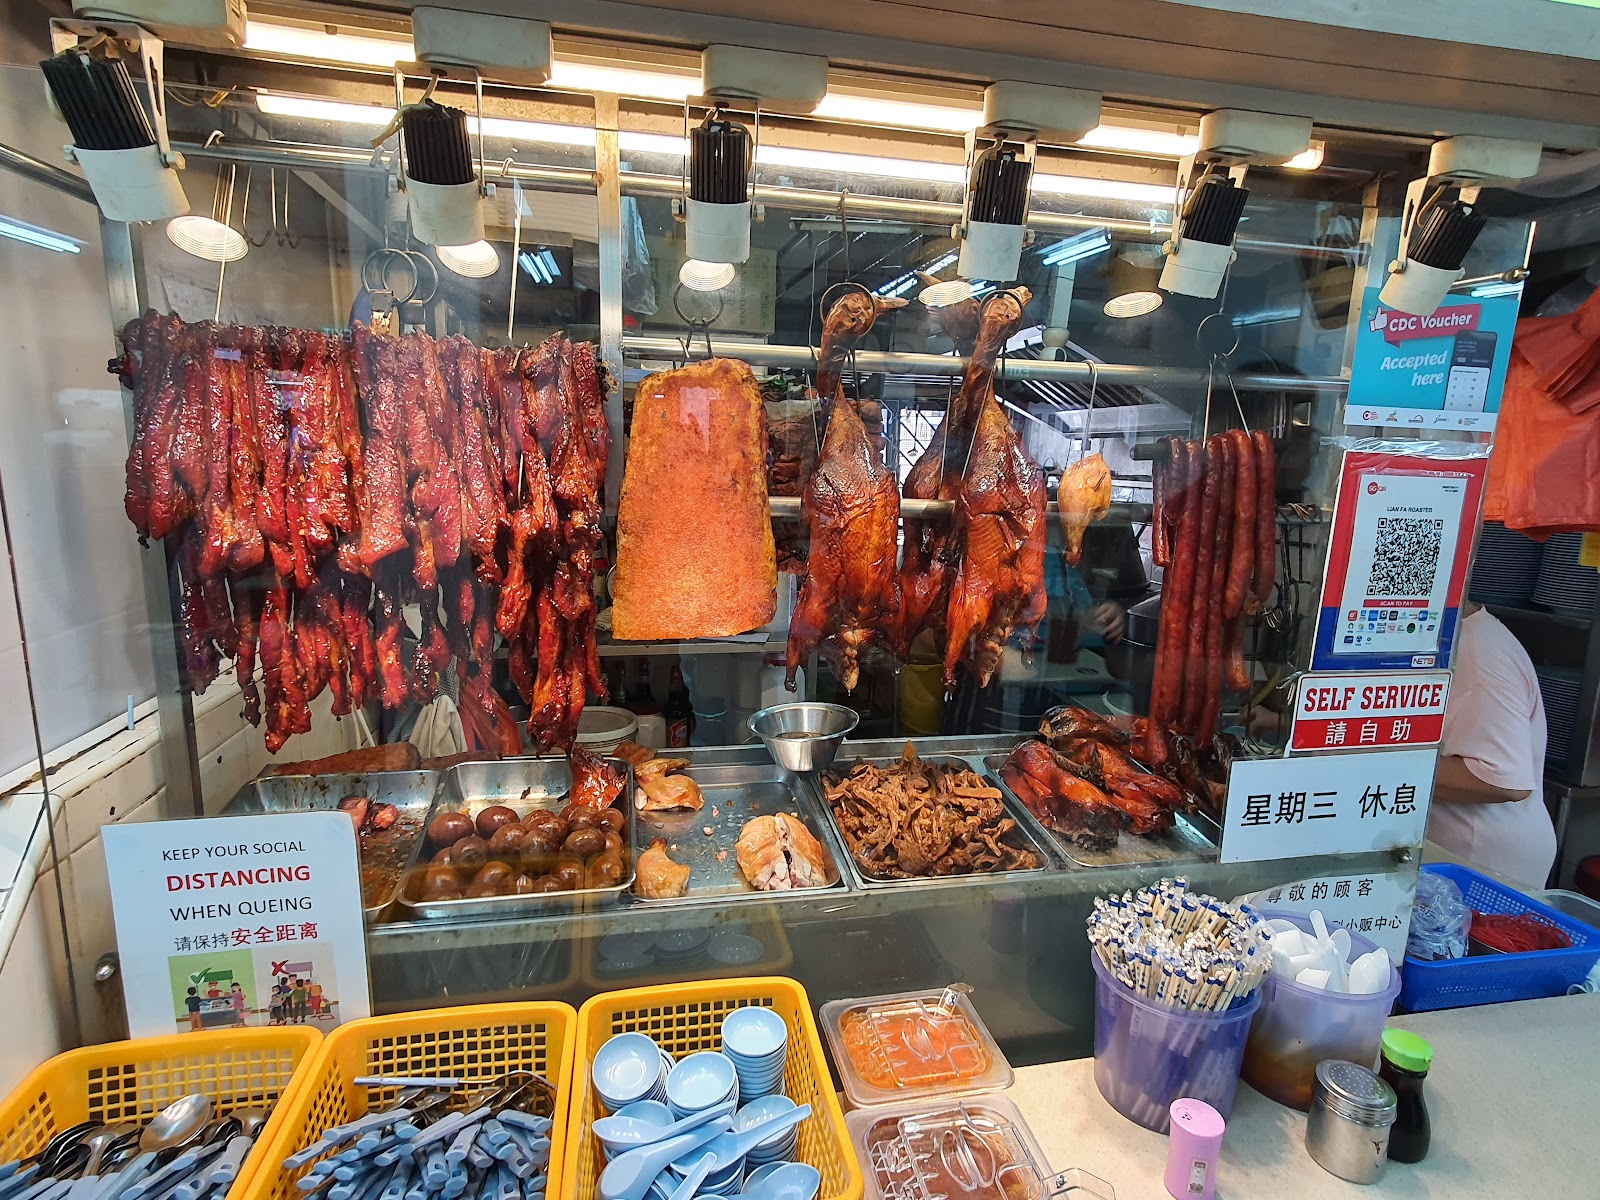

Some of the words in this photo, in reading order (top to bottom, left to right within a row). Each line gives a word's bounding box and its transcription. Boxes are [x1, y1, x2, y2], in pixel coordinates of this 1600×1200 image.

[1389, 316, 1417, 332] CDC
[1421, 313, 1473, 329] Voucher
[1380, 350, 1448, 370] Accepted
[1411, 371, 1444, 387] here
[1304, 687, 1356, 713] SELF
[1360, 683, 1443, 710] SERVICE
[1325, 719, 1412, 745] 請自助
[1241, 791, 1338, 827] 星期三
[1358, 783, 1417, 819] 休息
[162, 848, 200, 861] KEEP
[204, 844, 248, 858] YOUR
[253, 841, 306, 854] SOCIAL
[166, 865, 311, 892] DISTANCING
[170, 903, 231, 922] WHEN
[238, 896, 312, 916] QUEING
[174, 922, 318, 951] 请保持安全距离
